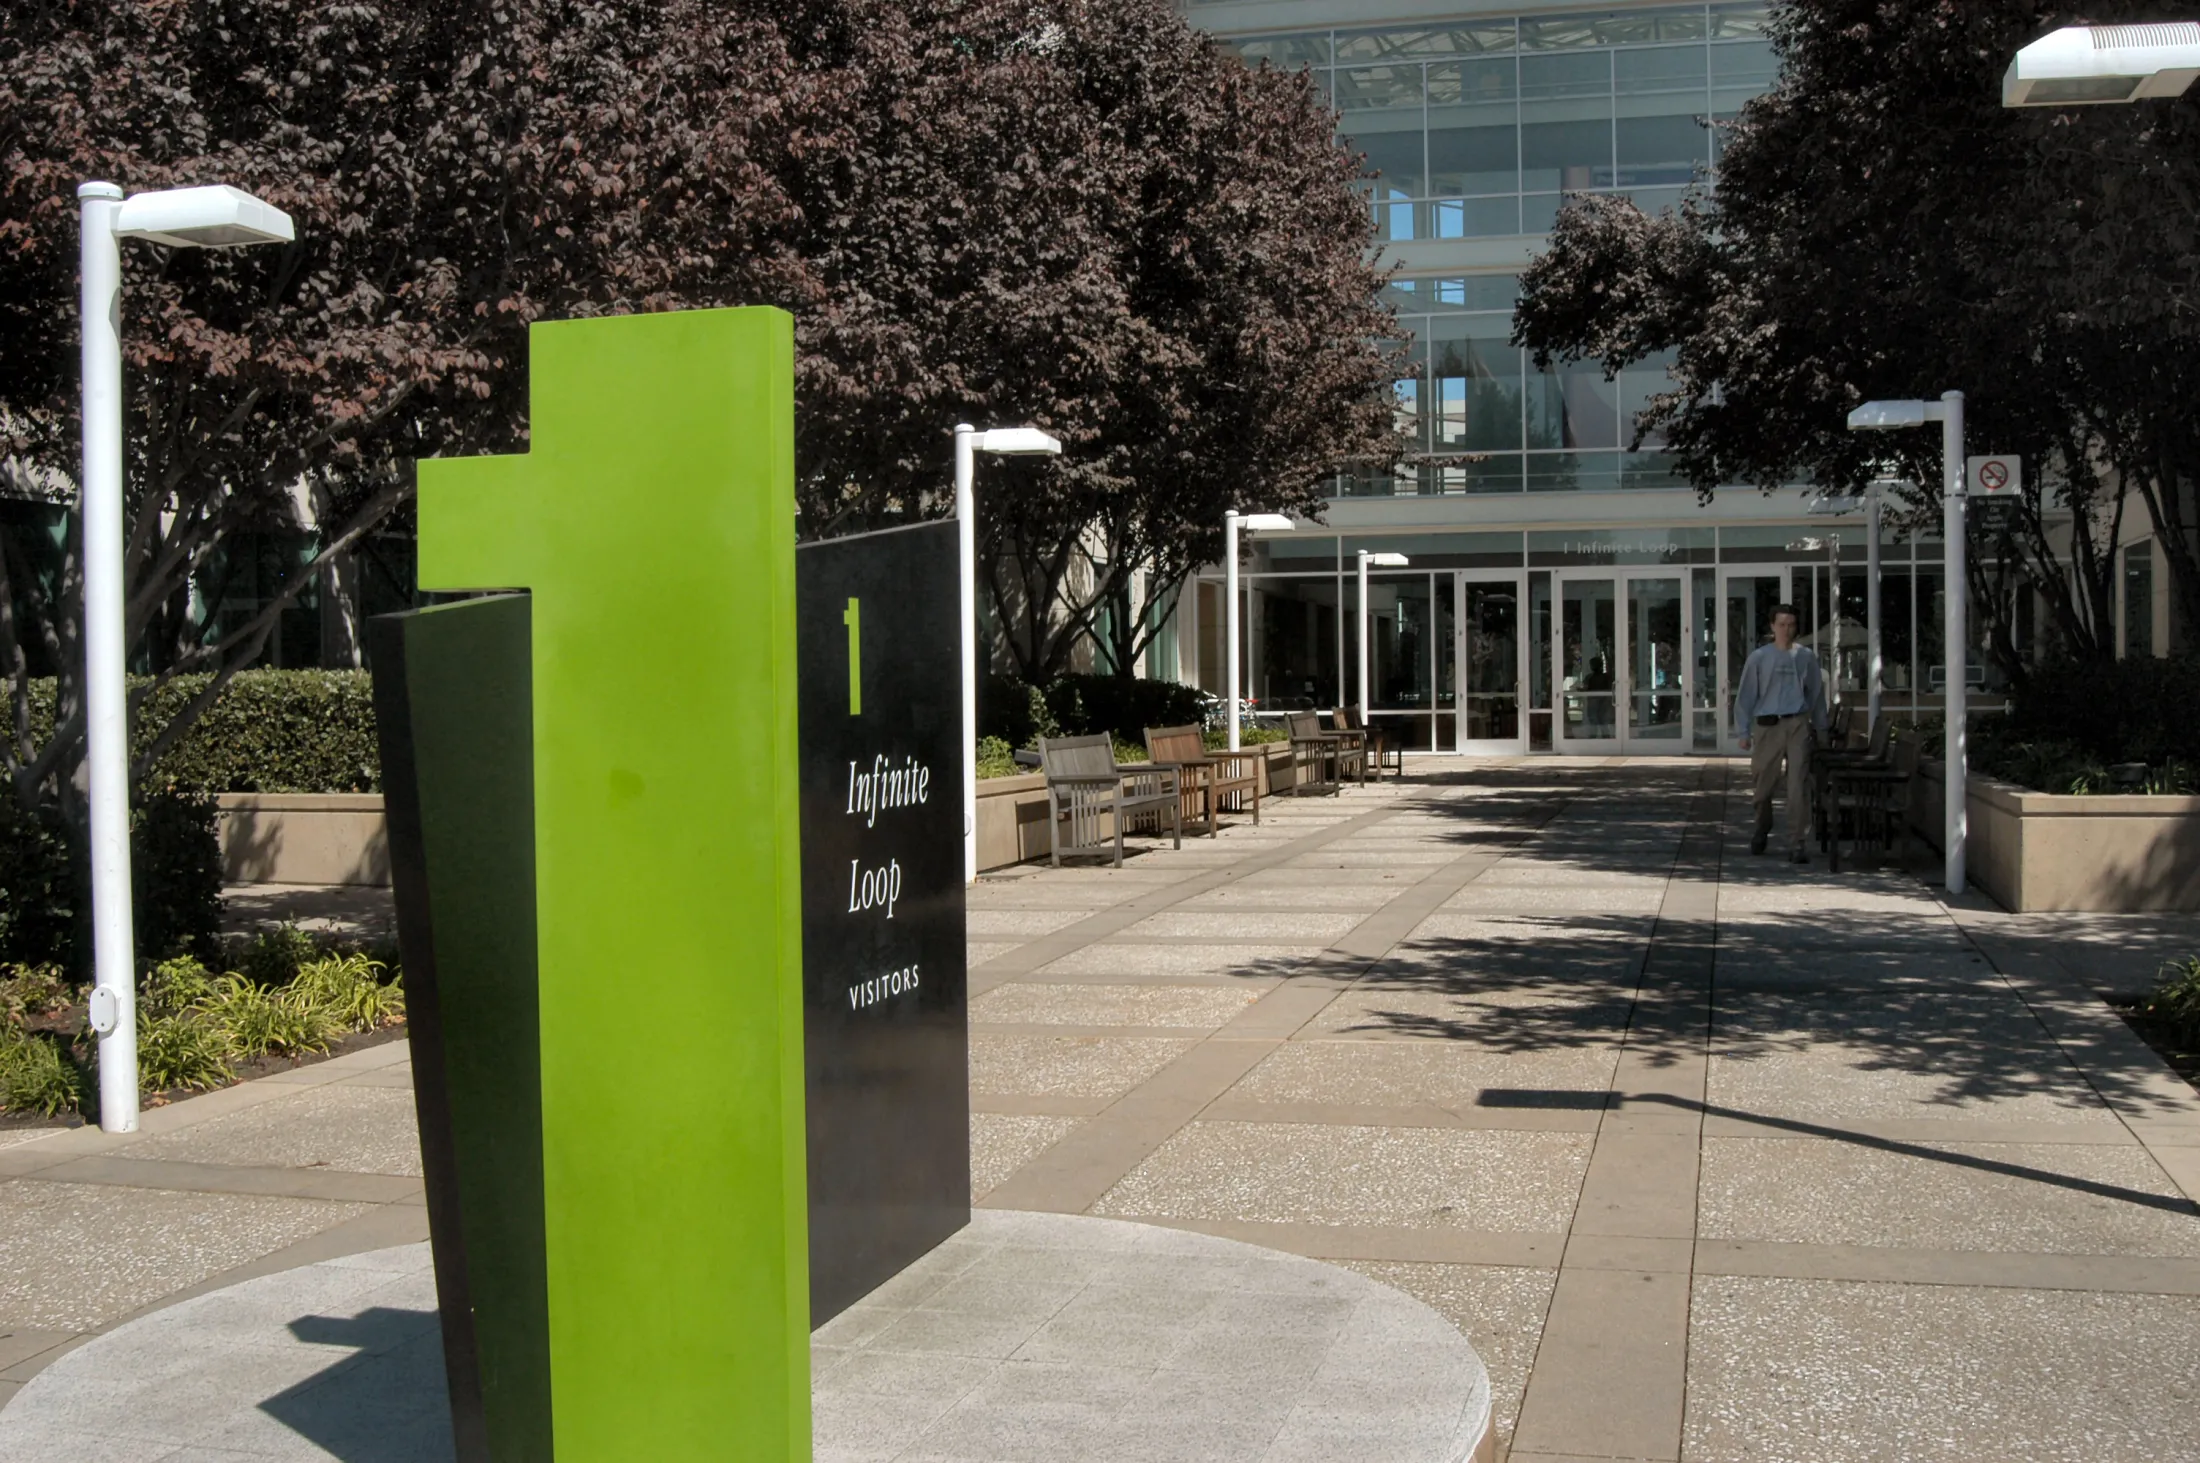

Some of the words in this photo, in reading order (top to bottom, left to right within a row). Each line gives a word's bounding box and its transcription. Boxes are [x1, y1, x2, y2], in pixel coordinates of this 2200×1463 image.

[1577, 540, 1632, 555] Infinite
[1639, 540, 1679, 556] Loop
[843, 597, 862, 716] 1
[846, 753, 930, 829] Infinite
[848, 857, 901, 919] Loop
[849, 963, 920, 1012] VISITORS
